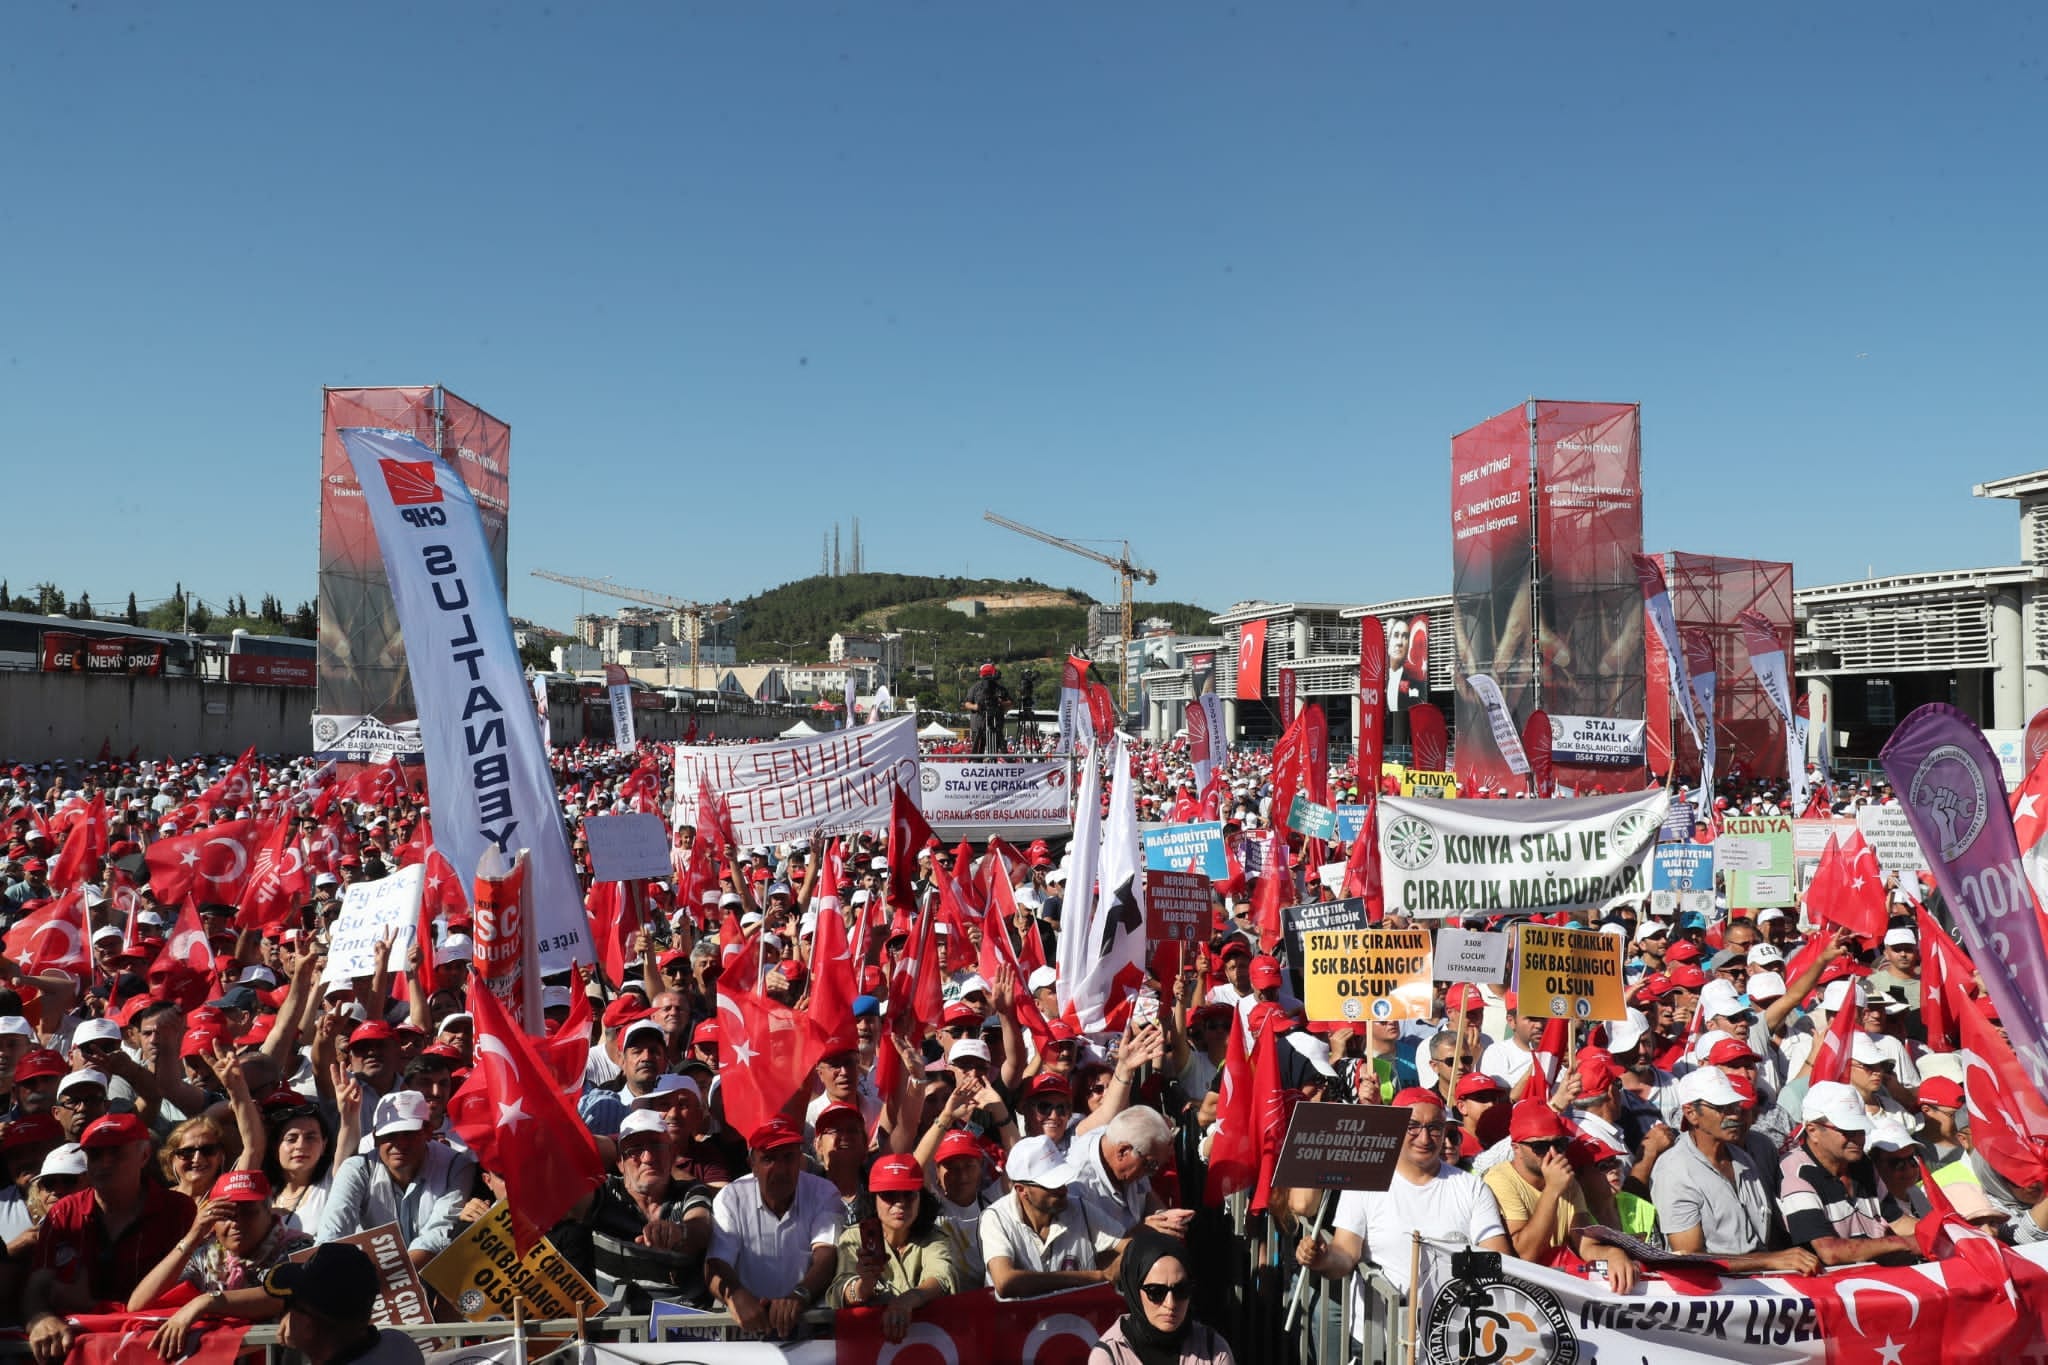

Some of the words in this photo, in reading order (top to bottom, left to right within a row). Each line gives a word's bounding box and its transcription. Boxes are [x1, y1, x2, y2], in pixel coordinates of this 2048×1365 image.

[1459, 468, 1479, 486] EMEK
[1480, 454, 1511, 478] MİTİNGİ
[1585, 720, 1616, 731] STAJ
[1556, 741, 1573, 749] SGK
[753, 746, 812, 787] SEN
[1575, 753, 1594, 761] 0544
[1595, 754, 1609, 763] 972
[1621, 755, 1630, 763] 25
[960, 765, 1025, 778] GAZİANTEP
[1405, 772, 1457, 787] KONYA
[945, 781, 971, 792] STAJ
[974, 780, 988, 791] VE
[990, 780, 1040, 794] ÇIRAKLIK
[936, 809, 973, 822] ÇIRAKLIK
[974, 809, 990, 820] SGK
[993, 808, 1041, 822] BAŞLANGICI
[1042, 807, 1068, 819] OLSUN
[1726, 819, 1791, 834] KONYA
[1146, 830, 1221, 847] MAĞDURİYETİN
[1443, 834, 1513, 865] KONYA
[1520, 833, 1572, 864] STAJ
[1575, 830, 1607, 861] VE
[1163, 841, 1209, 857] MALİYETİ
[1403, 879, 1503, 917] ÇIRAKLIK
[1509, 863, 1647, 910] MAĞDURLARI
[1288, 918, 1320, 931] EMEK
[1322, 910, 1360, 927] VERDİK
[1310, 935, 1338, 952] STAJ
[1342, 934, 1359, 951] VE
[1362, 933, 1424, 954] ÇIRAKLIK
[1524, 929, 1548, 947] STAJ
[1551, 932, 1565, 947] VE
[1567, 934, 1614, 956] ÇIRAKLIK
[1311, 957, 1337, 975] SGK
[1339, 956, 1425, 980] BAŞLANGICI
[1524, 952, 1548, 971] SGK
[1549, 954, 1616, 977] BAŞLANGICI
[1336, 979, 1398, 998] OLSUN
[1546, 977, 1594, 996] OLSUN
[1335, 1119, 1366, 1133] STAJ
[1293, 1130, 1398, 1149] MAĞDURİYETİNE
[1295, 1149, 1322, 1161] SON
[1325, 1149, 1386, 1163] VERİLSİN!
[371, 1233, 405, 1270] STAJ
[471, 1227, 503, 1260] SGK
[386, 1271, 412, 1291] VE
[534, 1252, 597, 1312] ÇIRAKLIK
